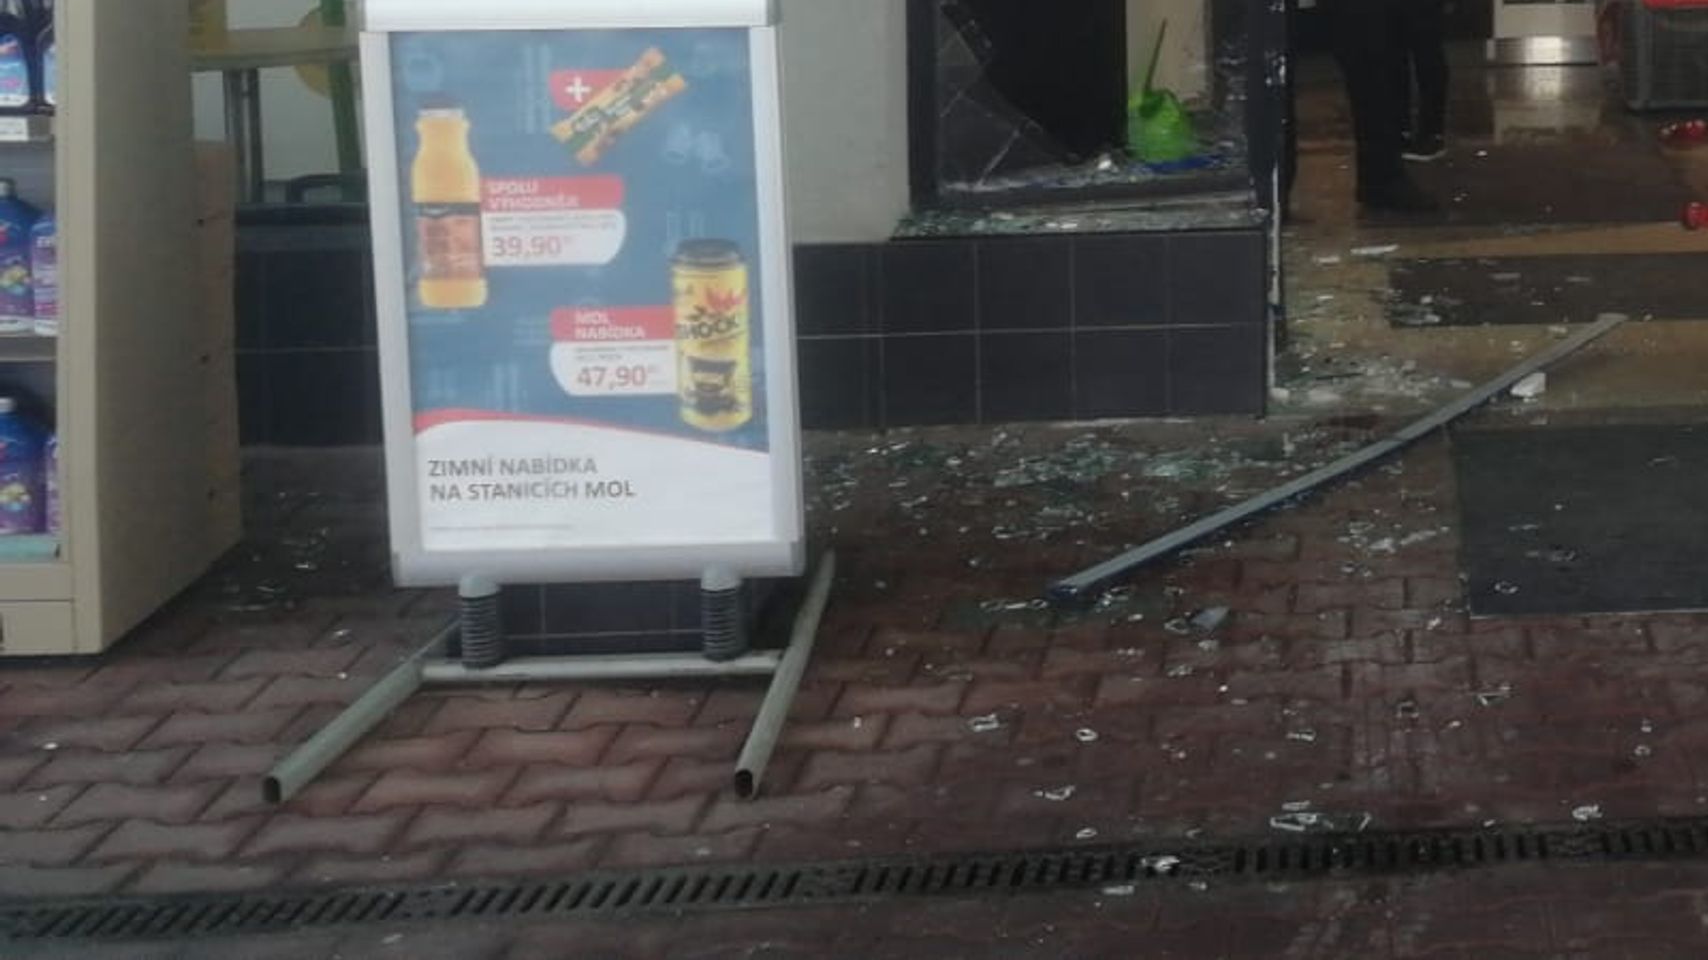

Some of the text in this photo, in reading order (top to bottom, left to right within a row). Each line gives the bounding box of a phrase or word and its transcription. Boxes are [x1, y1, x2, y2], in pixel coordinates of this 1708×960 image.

[492, 236, 562, 258] 39,90
[577, 365, 646, 390] 47,90
[428, 453, 598, 477] ZIMNÍ NABÍDKA
[430, 477, 637, 501] NA STANICÍCH MOL
